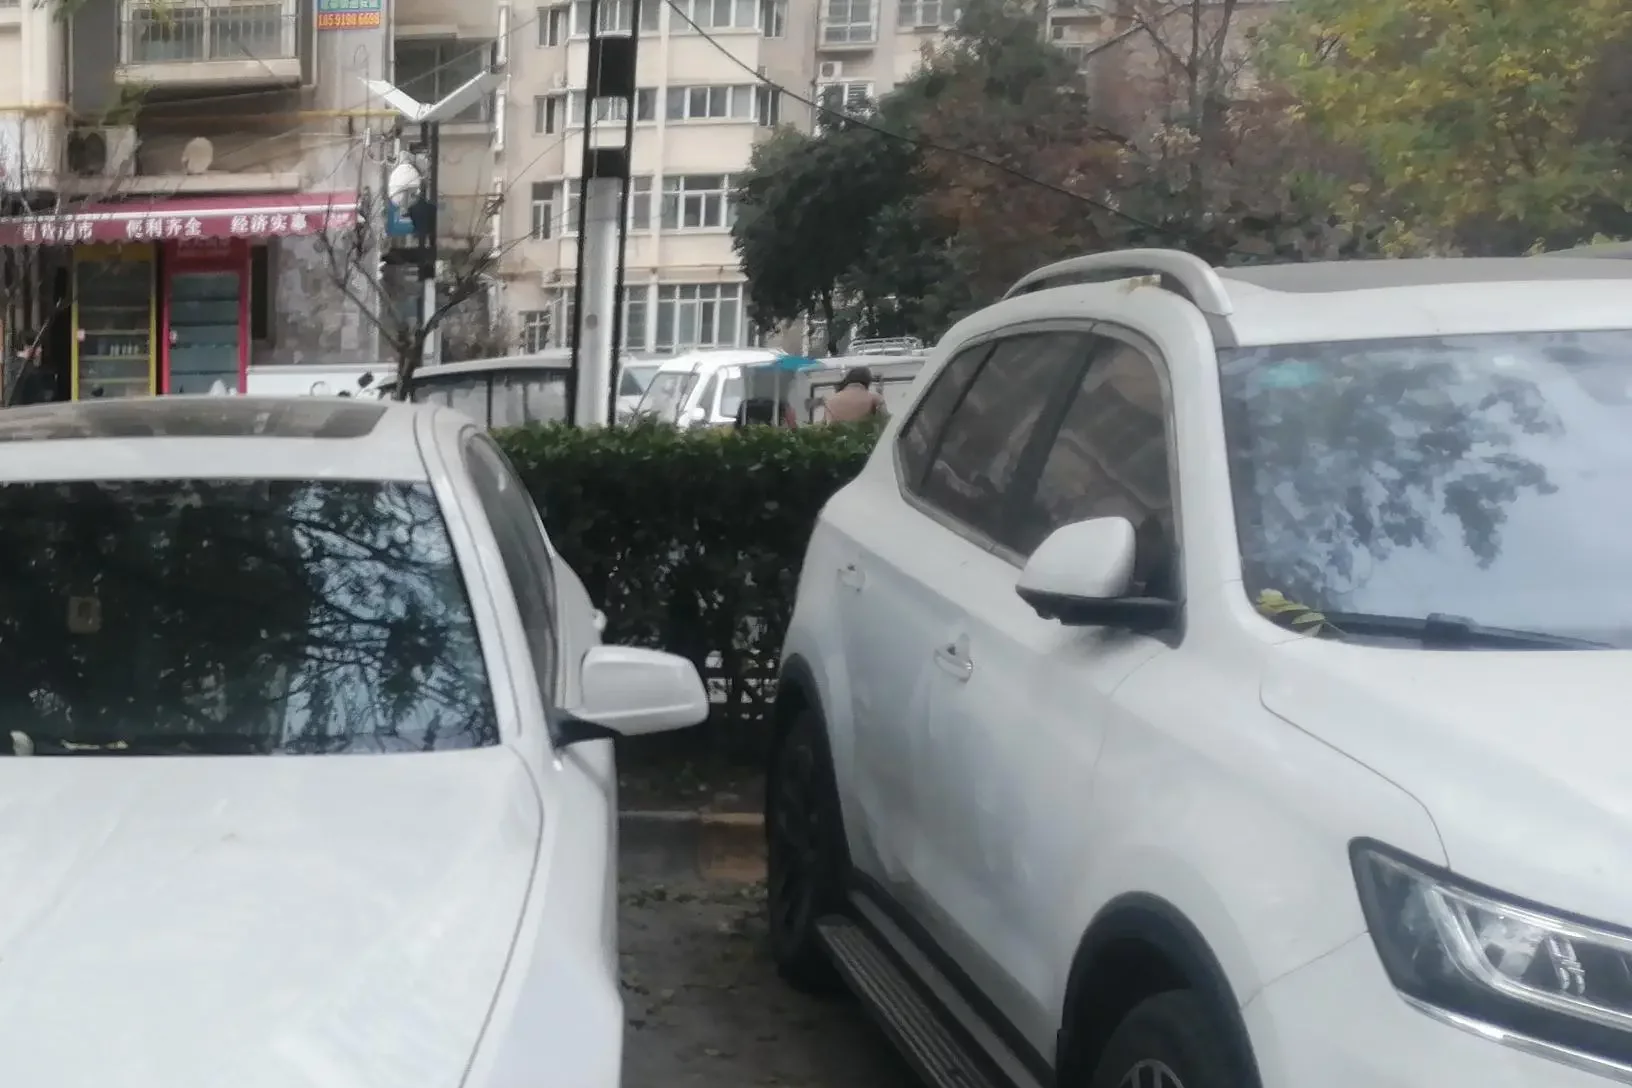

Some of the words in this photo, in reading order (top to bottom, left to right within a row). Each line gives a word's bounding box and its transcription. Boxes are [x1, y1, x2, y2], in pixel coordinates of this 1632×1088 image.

[126, 215, 204, 238] 便利齐全
[230, 212, 308, 233] 经济实惠
